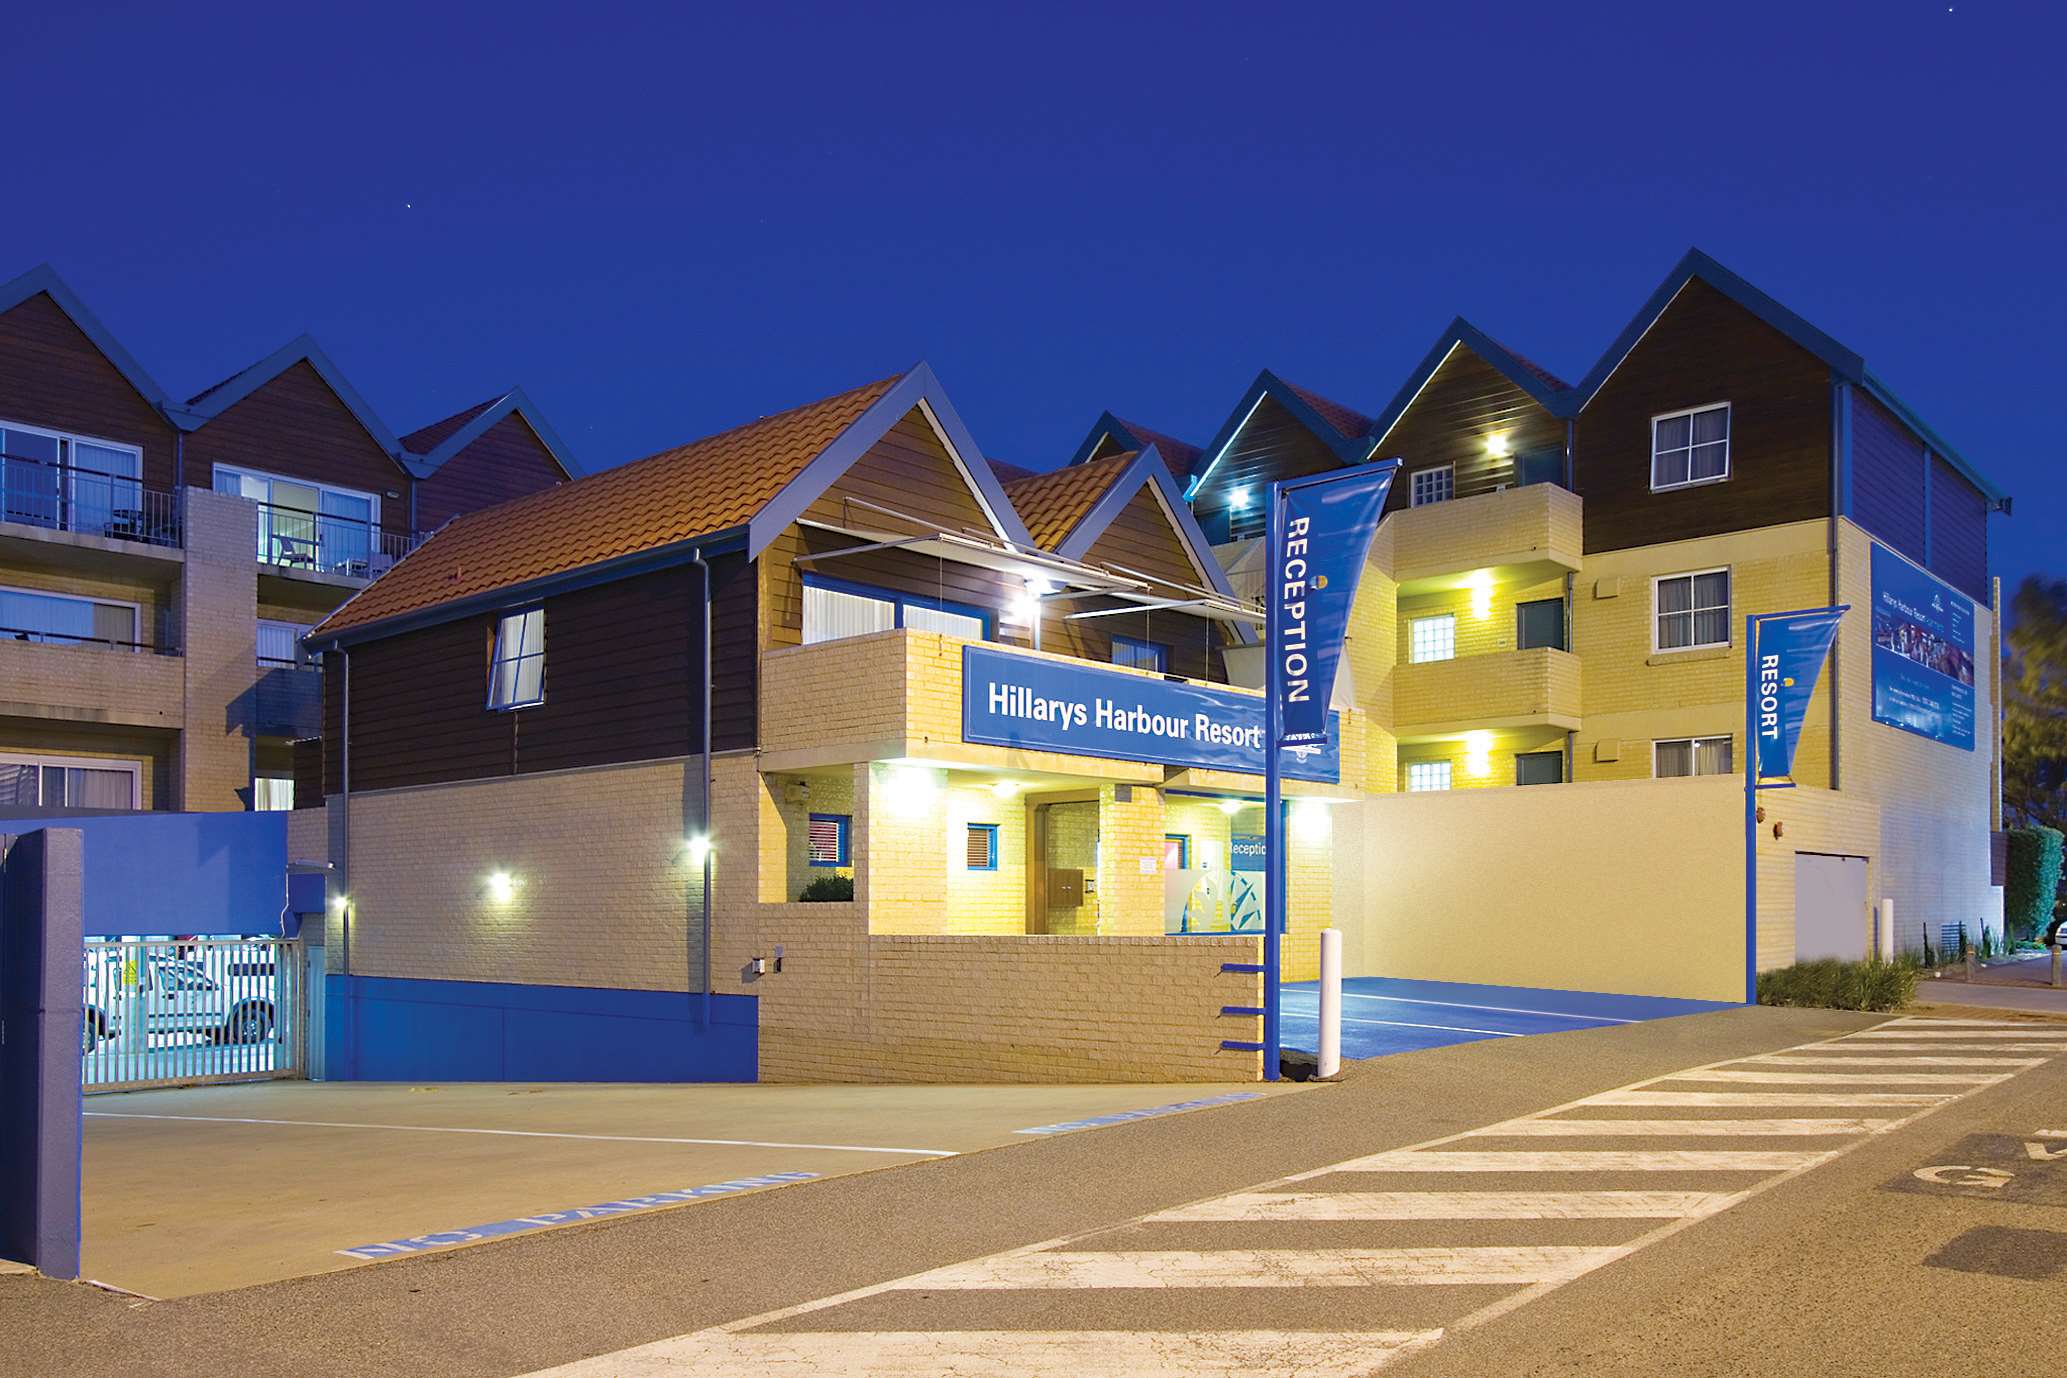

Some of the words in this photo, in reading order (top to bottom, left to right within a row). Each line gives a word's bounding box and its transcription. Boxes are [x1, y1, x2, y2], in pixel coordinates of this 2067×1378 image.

[1283, 516, 1311, 703] RECEPTION
[987, 682, 1088, 731] Hillarys
[1095, 697, 1190, 740] Harbour
[1194, 712, 1262, 750] Resort
[1760, 654, 1779, 740] RESORT
[333, 1230, 483, 1260] NO
[514, 1170, 822, 1226] PARKING
